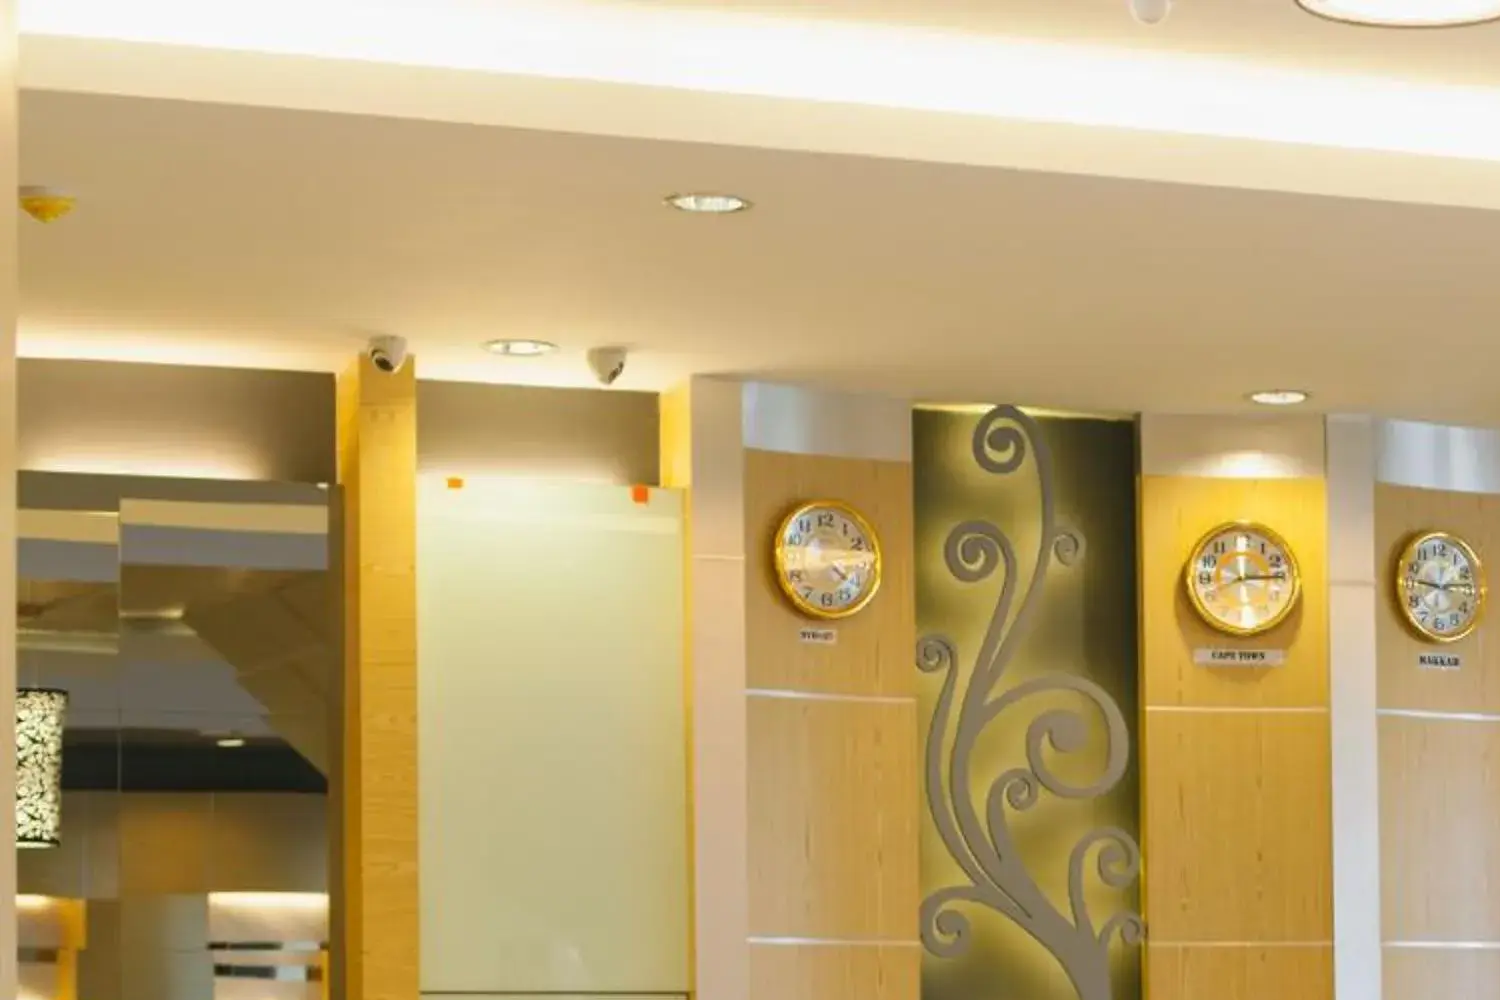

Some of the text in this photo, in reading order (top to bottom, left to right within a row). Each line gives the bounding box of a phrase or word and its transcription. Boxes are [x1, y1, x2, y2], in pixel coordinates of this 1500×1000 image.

[800, 520, 811, 532] 11
[818, 513, 834, 527] 12
[842, 523, 848, 535] 1
[852, 538, 862, 550] 2
[1214, 542, 1225, 553] 11
[1418, 549, 1427, 560] 11
[1433, 544, 1447, 557] 12
[1269, 555, 1281, 567] 2
[1453, 554, 1458, 565] 1
[1408, 563, 1419, 573] 10
[1460, 567, 1469, 579] 2
[804, 587, 814, 599] 7
[1459, 602, 1467, 613] 4
[1420, 611, 1428, 623] 7
[1434, 618, 1445, 631] 6
[1211, 651, 1265, 661] CAPE TOWN
